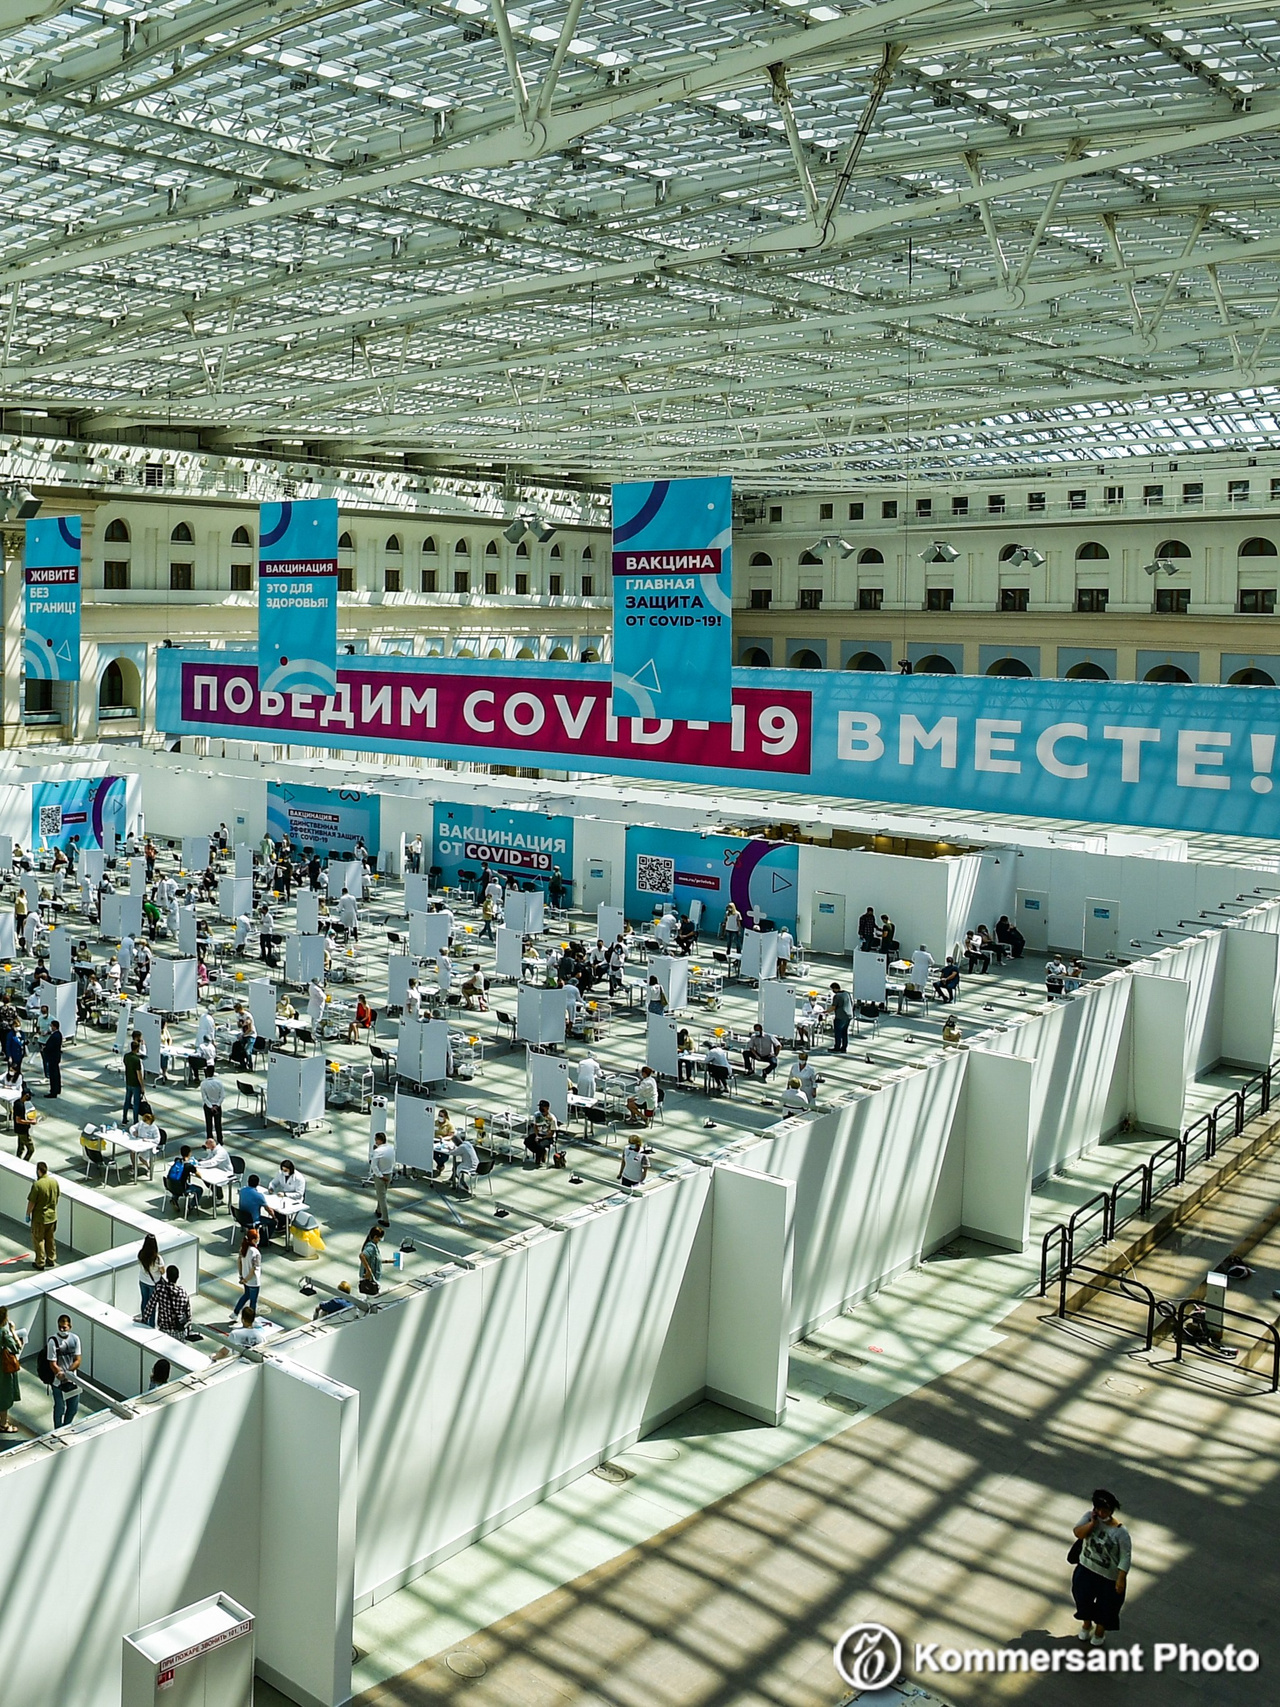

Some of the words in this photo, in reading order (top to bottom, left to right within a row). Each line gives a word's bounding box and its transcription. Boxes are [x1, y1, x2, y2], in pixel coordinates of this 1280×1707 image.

[266, 563, 333, 574] ВАКЦИНАЦИЯ
[626, 555, 714, 571] ВАКЦИНА
[30, 569, 76, 582] ЖИВИТЕ
[266, 584, 288, 593] ЭТО
[290, 584, 312, 594] ДЛЯ
[626, 578, 694, 590] ГЛАВНАЯ
[30, 587, 49, 598] БЕЗ
[30, 602, 76, 614] ГРАНИЦ!
[266, 598, 328, 608] ЗДОРОВЬЯ!
[626, 596, 704, 610] ЗАЩИТА
[626, 616, 645, 626] ОТ
[649, 616, 722, 626] COVID-19!
[194, 675, 438, 728] ПОБЕДИМ
[462, 690, 798, 756] COVID-19
[837, 710, 1277, 794] ВМЕСТЕ!
[290, 810, 332, 820] ВАКЦИНАЦИЯ
[290, 820, 338, 830] ЕДИНСТВЕННАЯ
[290, 826, 336, 838] ЭФФЕКТИВНАЯ
[338, 833, 365, 841] ЗАЩИТА
[301, 834, 328, 843] COVID-19
[440, 822, 566, 854] ВАКЦИНАЦИЯ
[439, 840, 462, 856] ОТ
[466, 844, 550, 869] COVID-19
[162, 1659, 174, 1668] ПРИ
[175, 1646, 200, 1664] ПОЖАРЕ
[200, 1634, 227, 1650] ЗВОНИТЬ
[240, 1624, 248, 1632] 112
